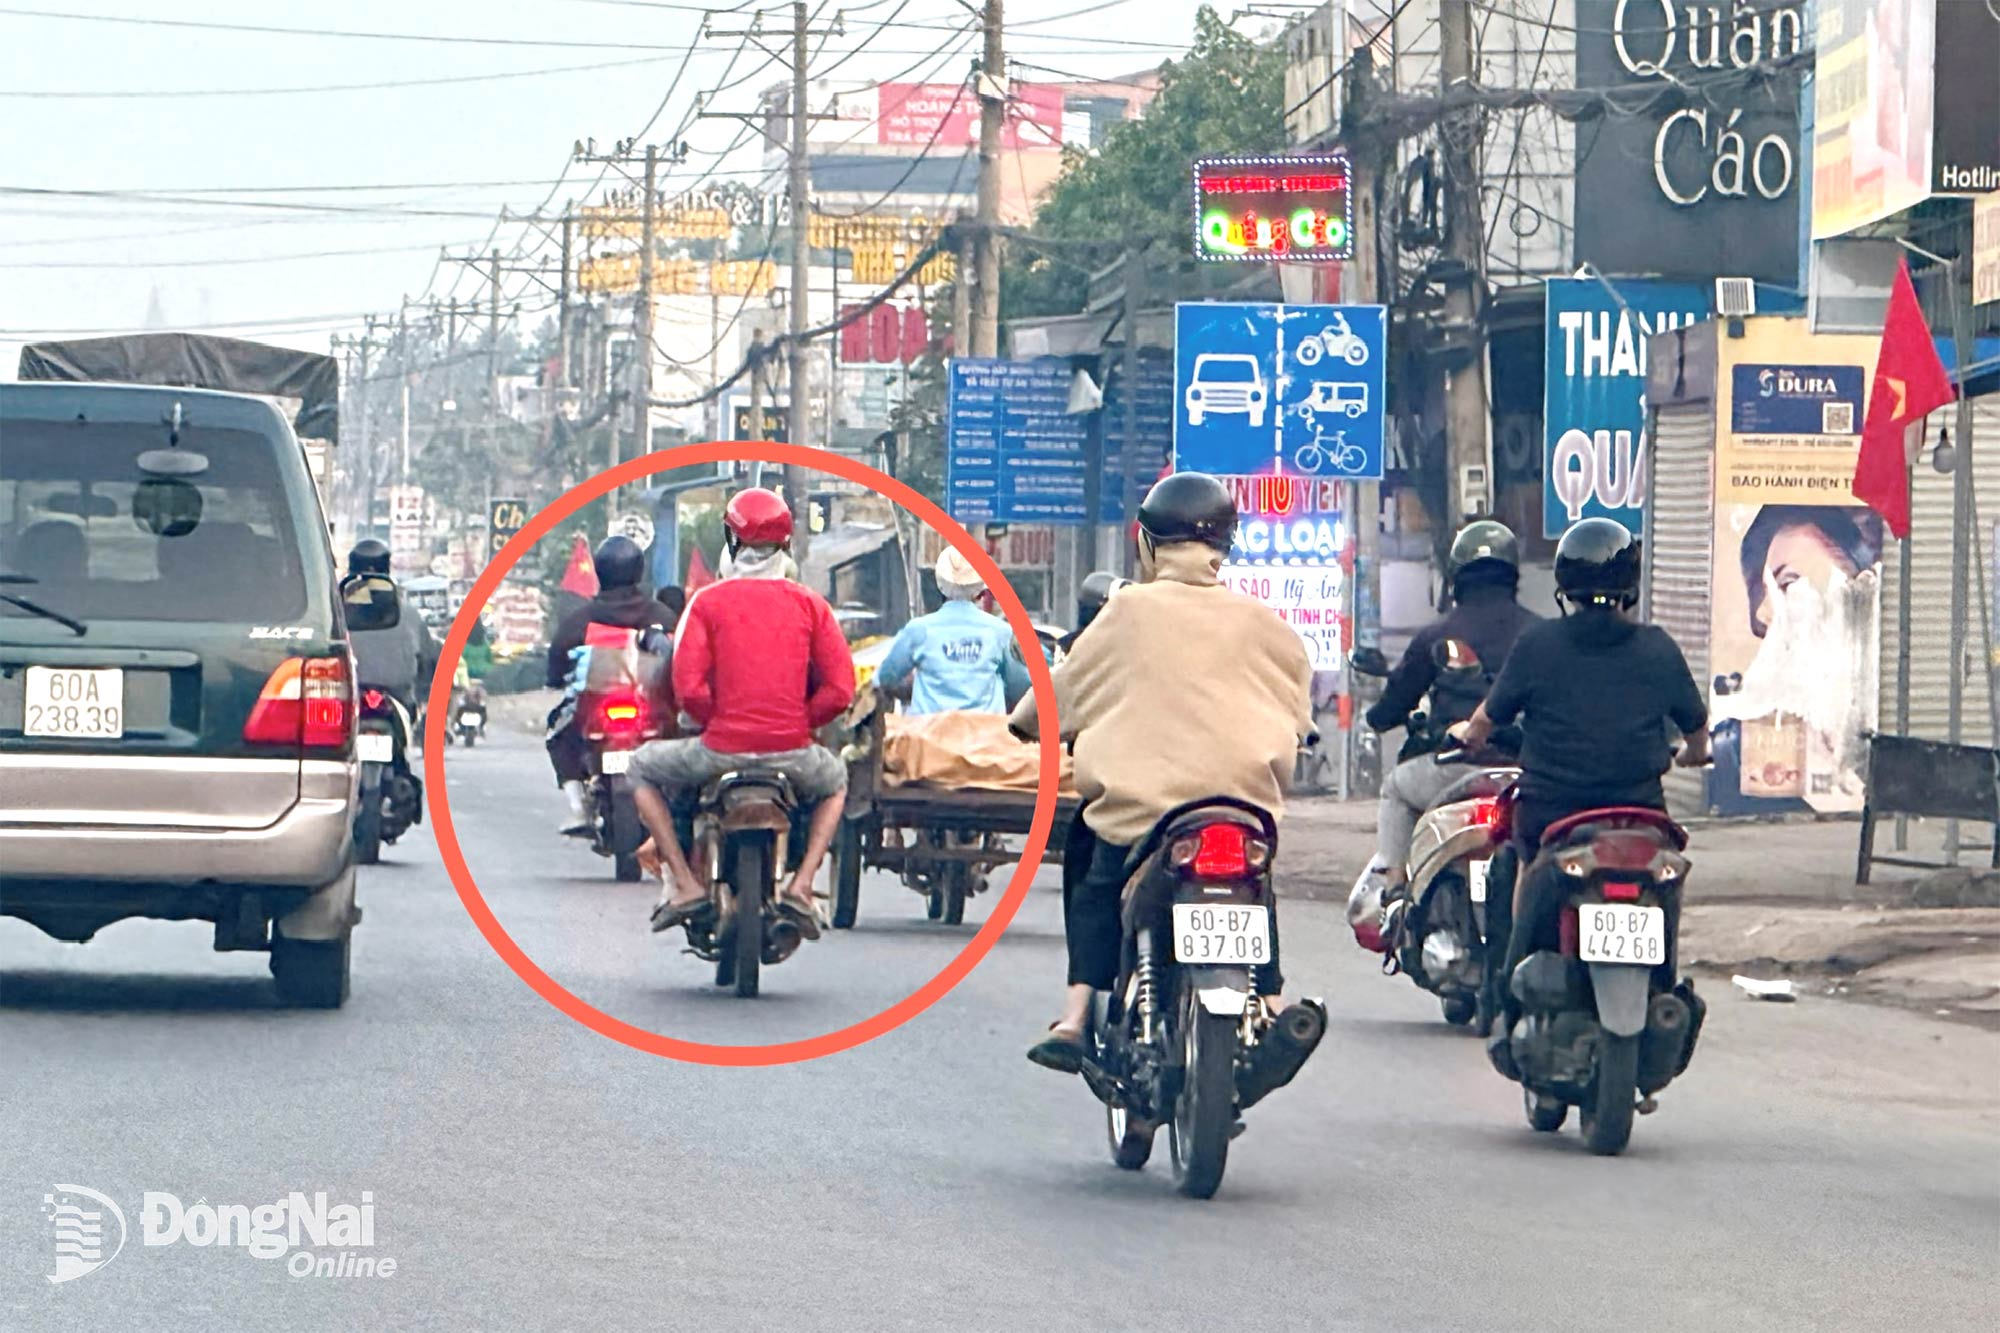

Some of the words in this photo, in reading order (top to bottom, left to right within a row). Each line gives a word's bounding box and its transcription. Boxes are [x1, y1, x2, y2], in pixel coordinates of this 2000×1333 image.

[1654, 108, 1793, 205] Cáo
[1778, 378, 1837, 393] DURA
[49, 673, 100, 702] 60A
[28, 704, 120, 735] 238.39
[1183, 934, 1264, 959] 837.08
